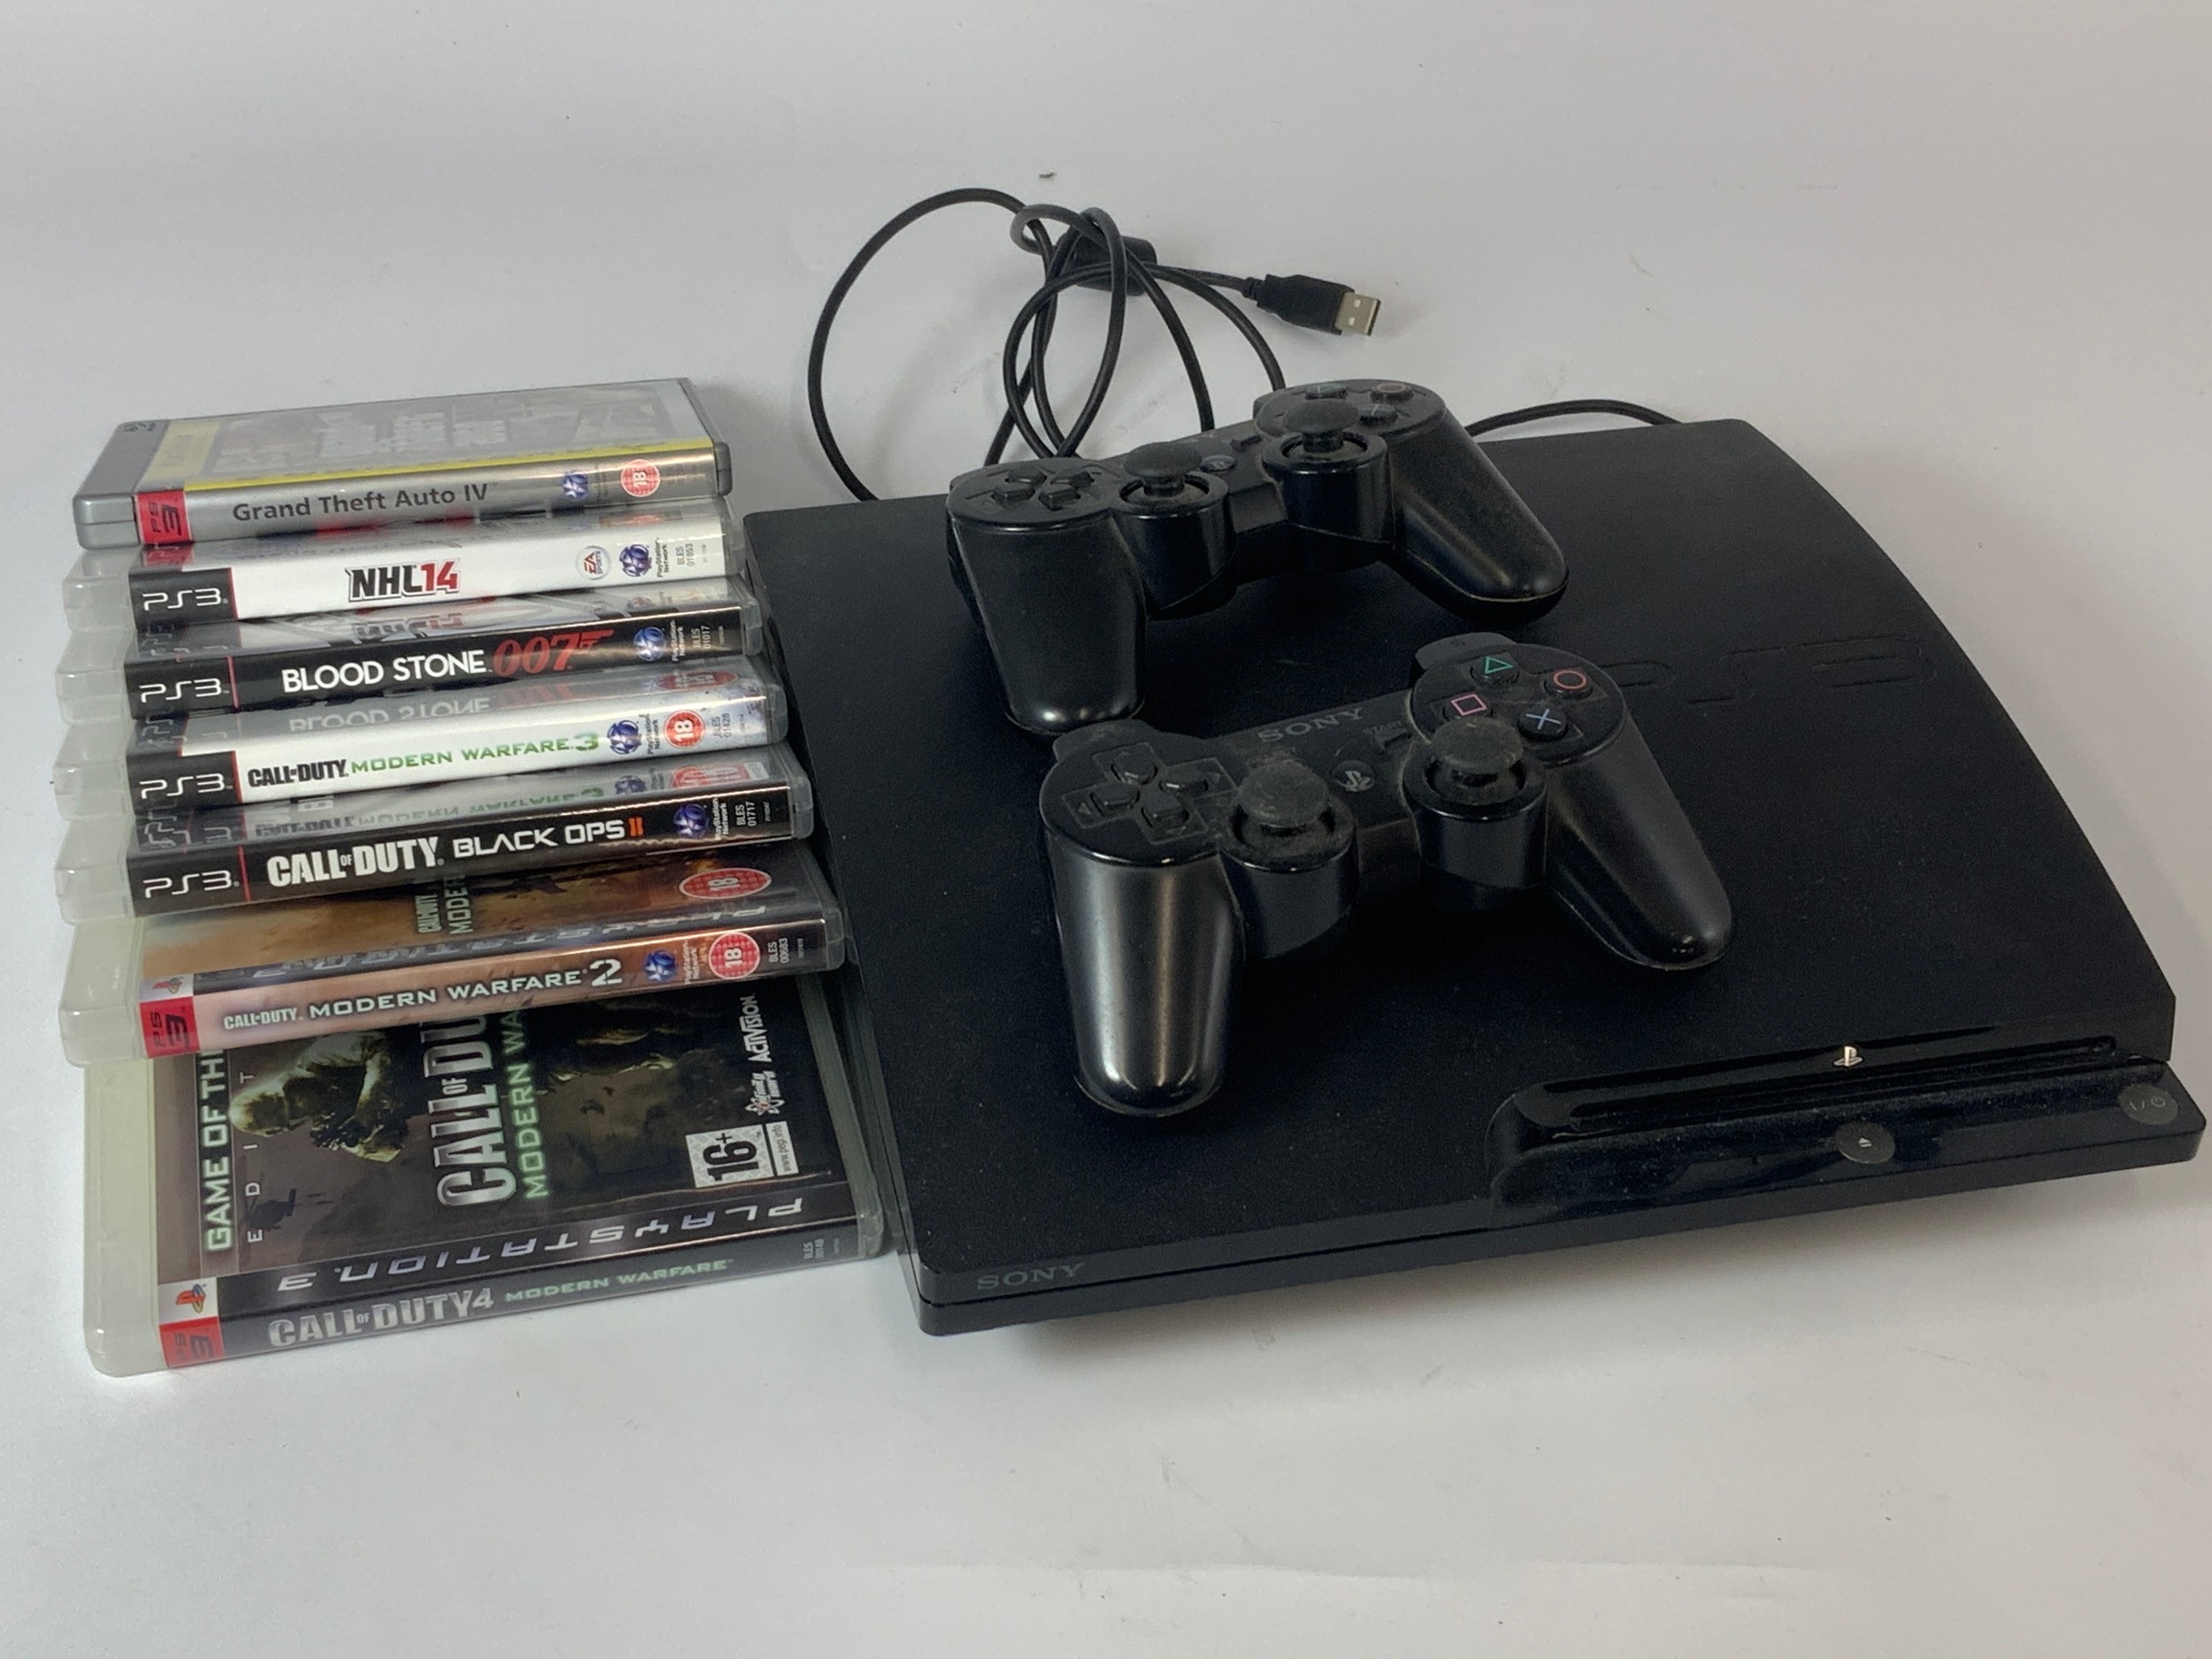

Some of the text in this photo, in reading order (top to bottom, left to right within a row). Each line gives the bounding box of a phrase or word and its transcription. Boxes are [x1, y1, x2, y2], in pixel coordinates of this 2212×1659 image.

[631, 470, 648, 488] 18
[232, 483, 488, 522] Grand Theft Auto IV
[583, 552, 597, 574] EA
[676, 545, 685, 566] BLES
[142, 588, 222, 611] PS3
[691, 627, 702, 649] BLES
[281, 628, 588, 694] BLOOD STONE 007
[139, 678, 222, 703] PS3
[673, 719, 695, 741] 18
[1257, 707, 1363, 743] SONY
[351, 747, 453, 774] MODERN
[459, 737, 569, 761] WARFARE
[573, 732, 599, 752] 3
[139, 772, 224, 799] PS3
[720, 802, 729, 835] Network
[734, 804, 746, 826] BLES
[745, 801, 757, 826] 01717
[266, 847, 346, 887] CALL
[352, 836, 439, 877] DUTY
[453, 826, 559, 858] BLACK
[565, 819, 626, 845] OPS
[142, 870, 232, 899] PS3
[724, 948, 743, 968] 18
[768, 941, 779, 963] BLES
[309, 988, 437, 1018] MODERN
[447, 969, 582, 1000] WARFARE
[589, 958, 623, 987] 2
[739, 994, 773, 1063] ACTIVISION
[442, 1077, 469, 1096] OF
[428, 1083, 518, 1207] CALL
[507, 1062, 550, 1200] MODERN
[200, 1049, 233, 1251] GAME OF TH
[277, 1196, 803, 1293] PLAYSTATION 3
[977, 1262, 1086, 1291] SONY
[268, 1310, 359, 1348] CALL
[357, 1311, 371, 1324] OF
[504, 1278, 610, 1302] MODERN
[618, 1260, 728, 1285] WARFARE
